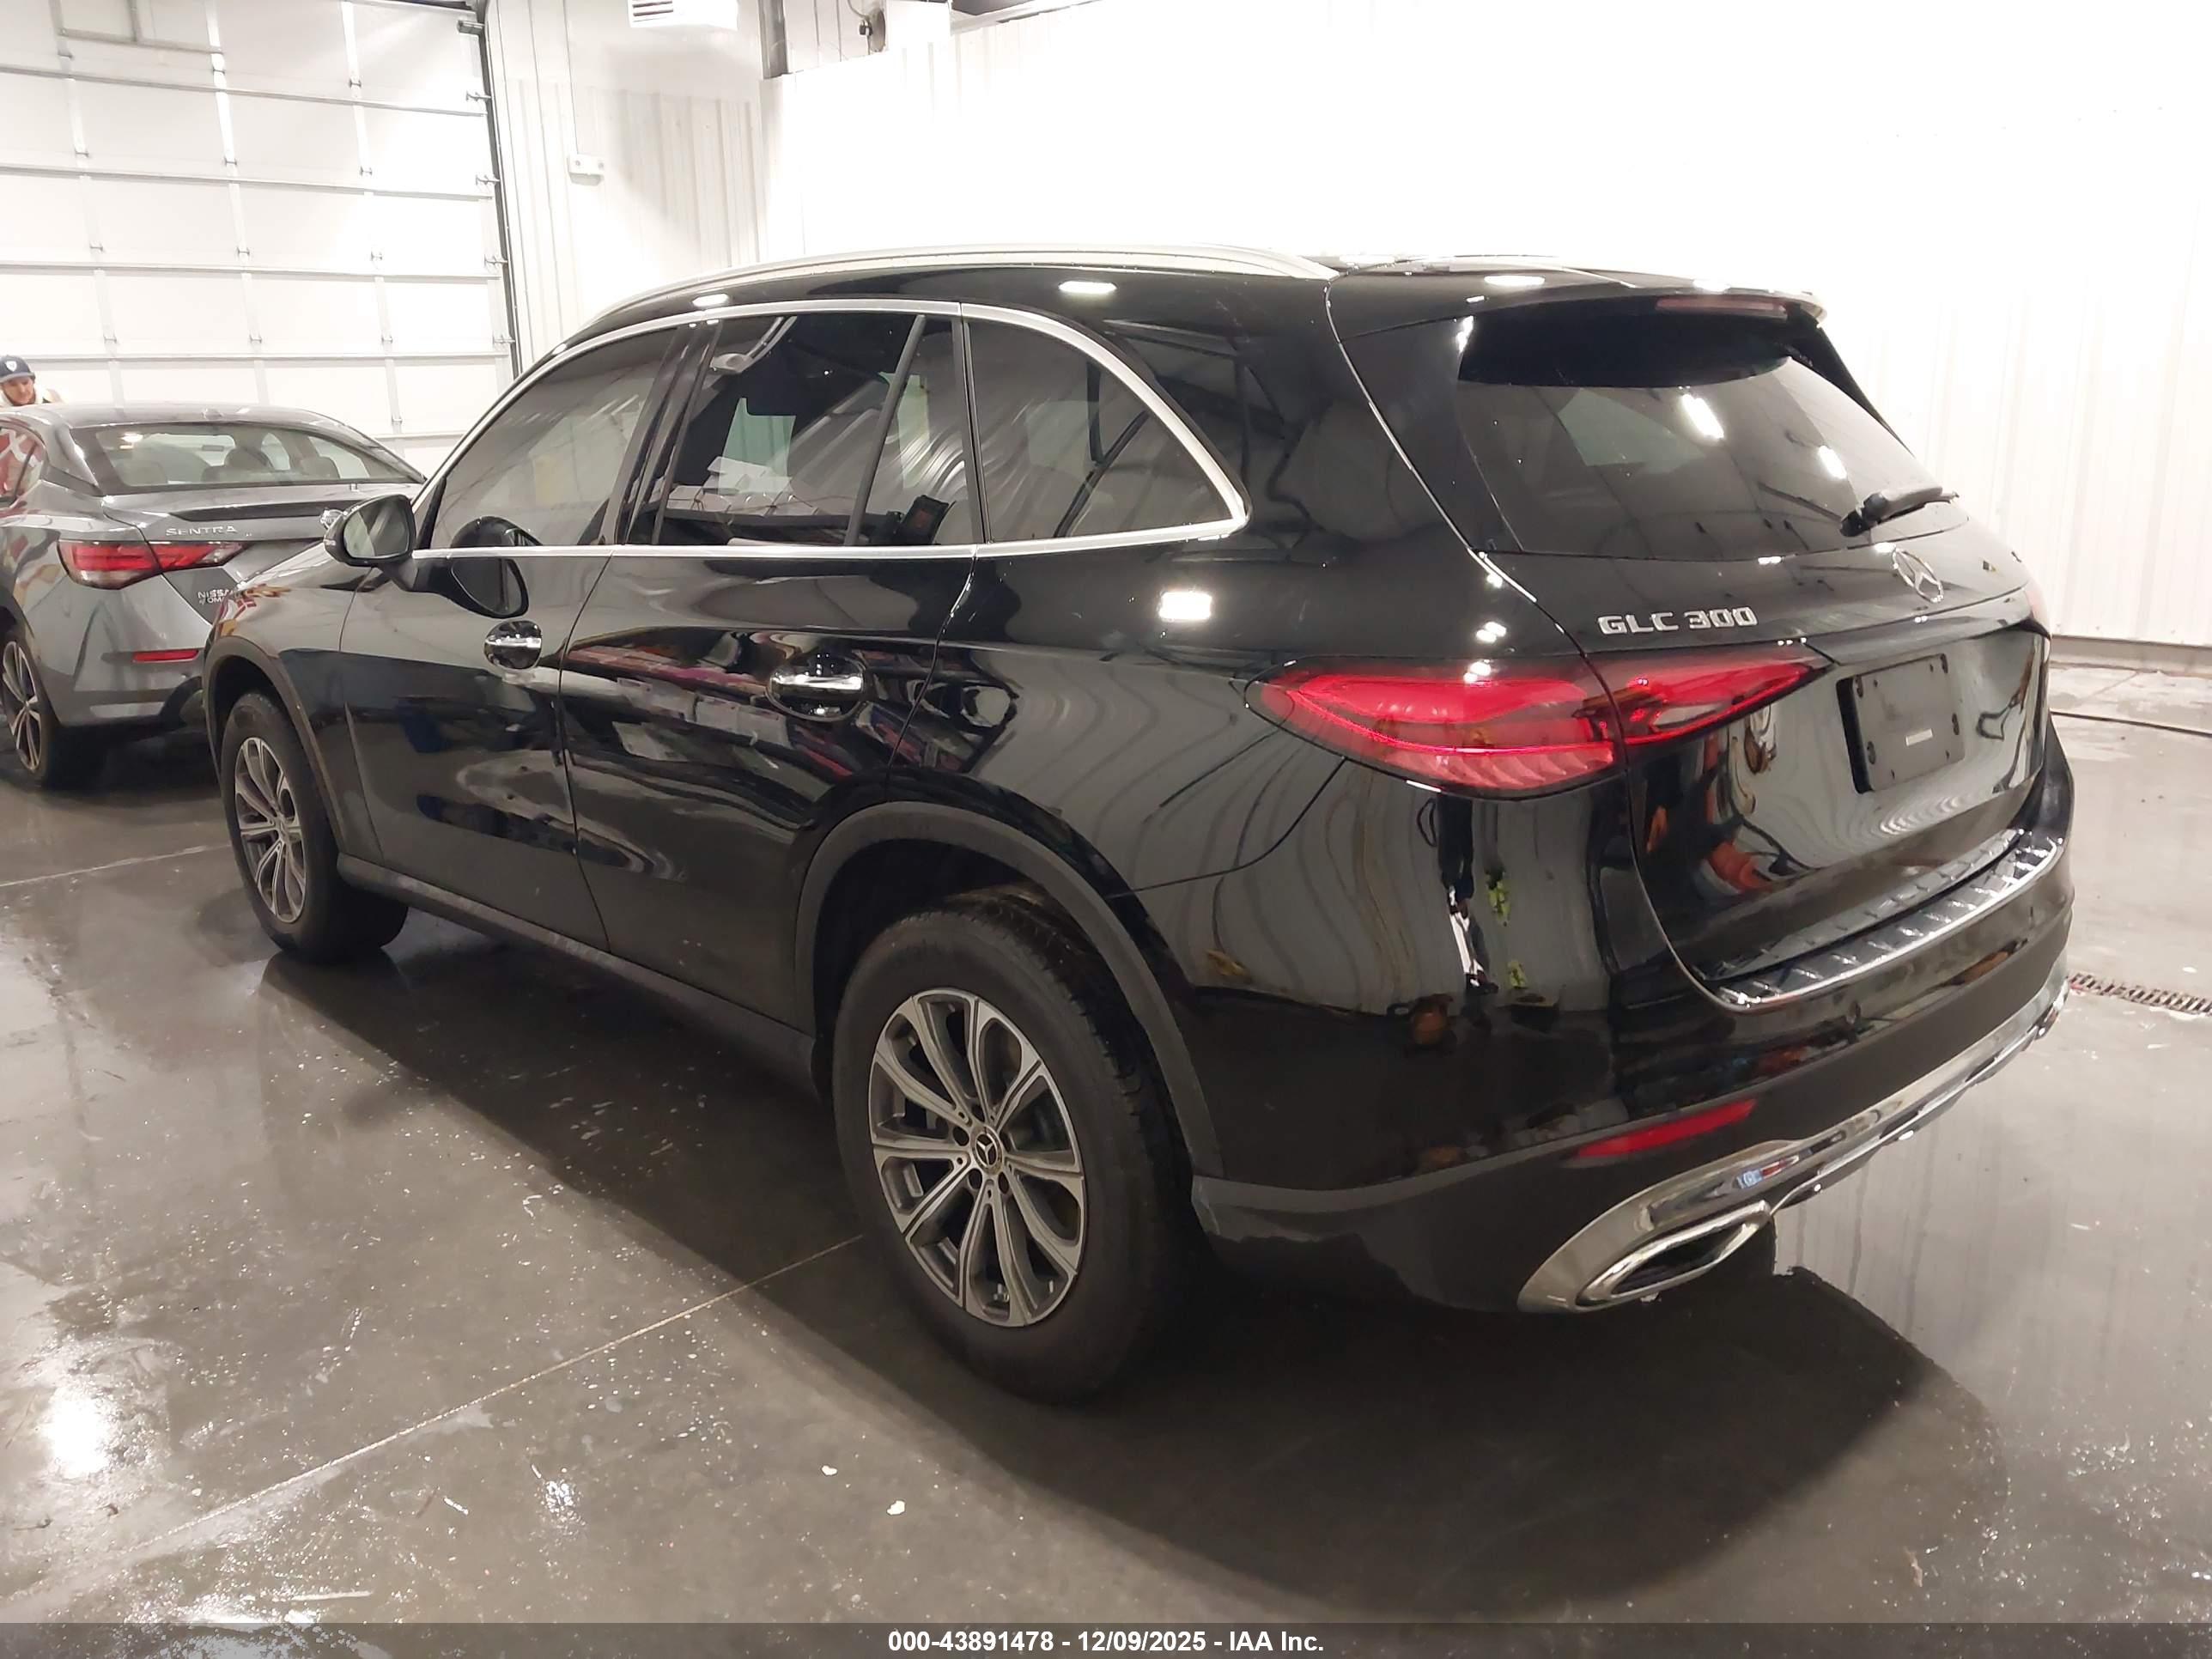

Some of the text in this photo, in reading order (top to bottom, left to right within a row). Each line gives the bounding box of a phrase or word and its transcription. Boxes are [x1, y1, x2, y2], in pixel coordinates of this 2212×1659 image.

[166, 526, 237, 537] SENTRA
[1597, 606, 1759, 635] GLC 300
